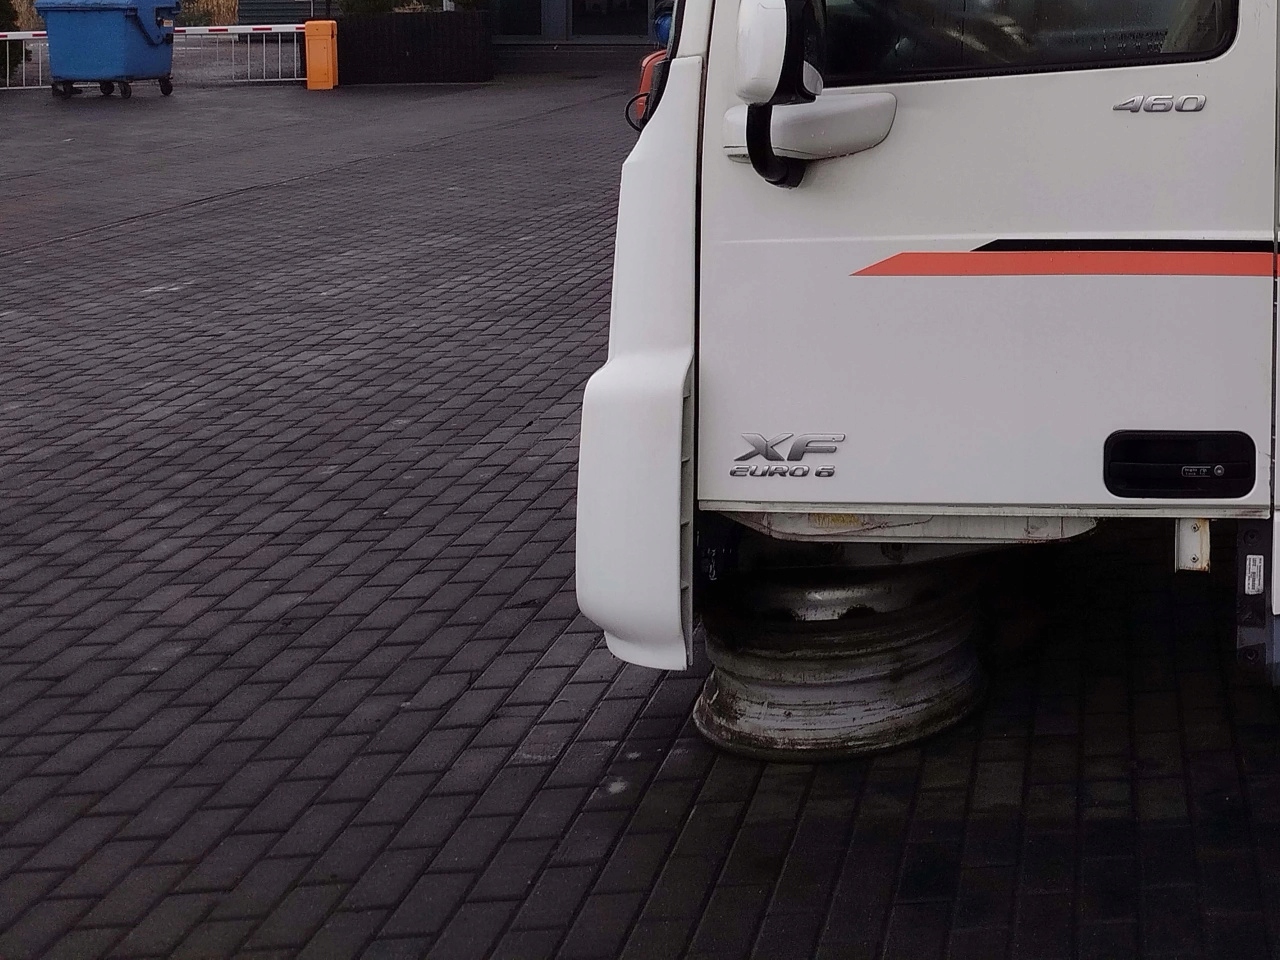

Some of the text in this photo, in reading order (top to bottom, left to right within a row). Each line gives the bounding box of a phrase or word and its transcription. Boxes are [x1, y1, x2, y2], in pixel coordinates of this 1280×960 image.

[1112, 94, 1207, 113] 460
[733, 433, 846, 462] XF
[729, 465, 836, 477] EURO 6
